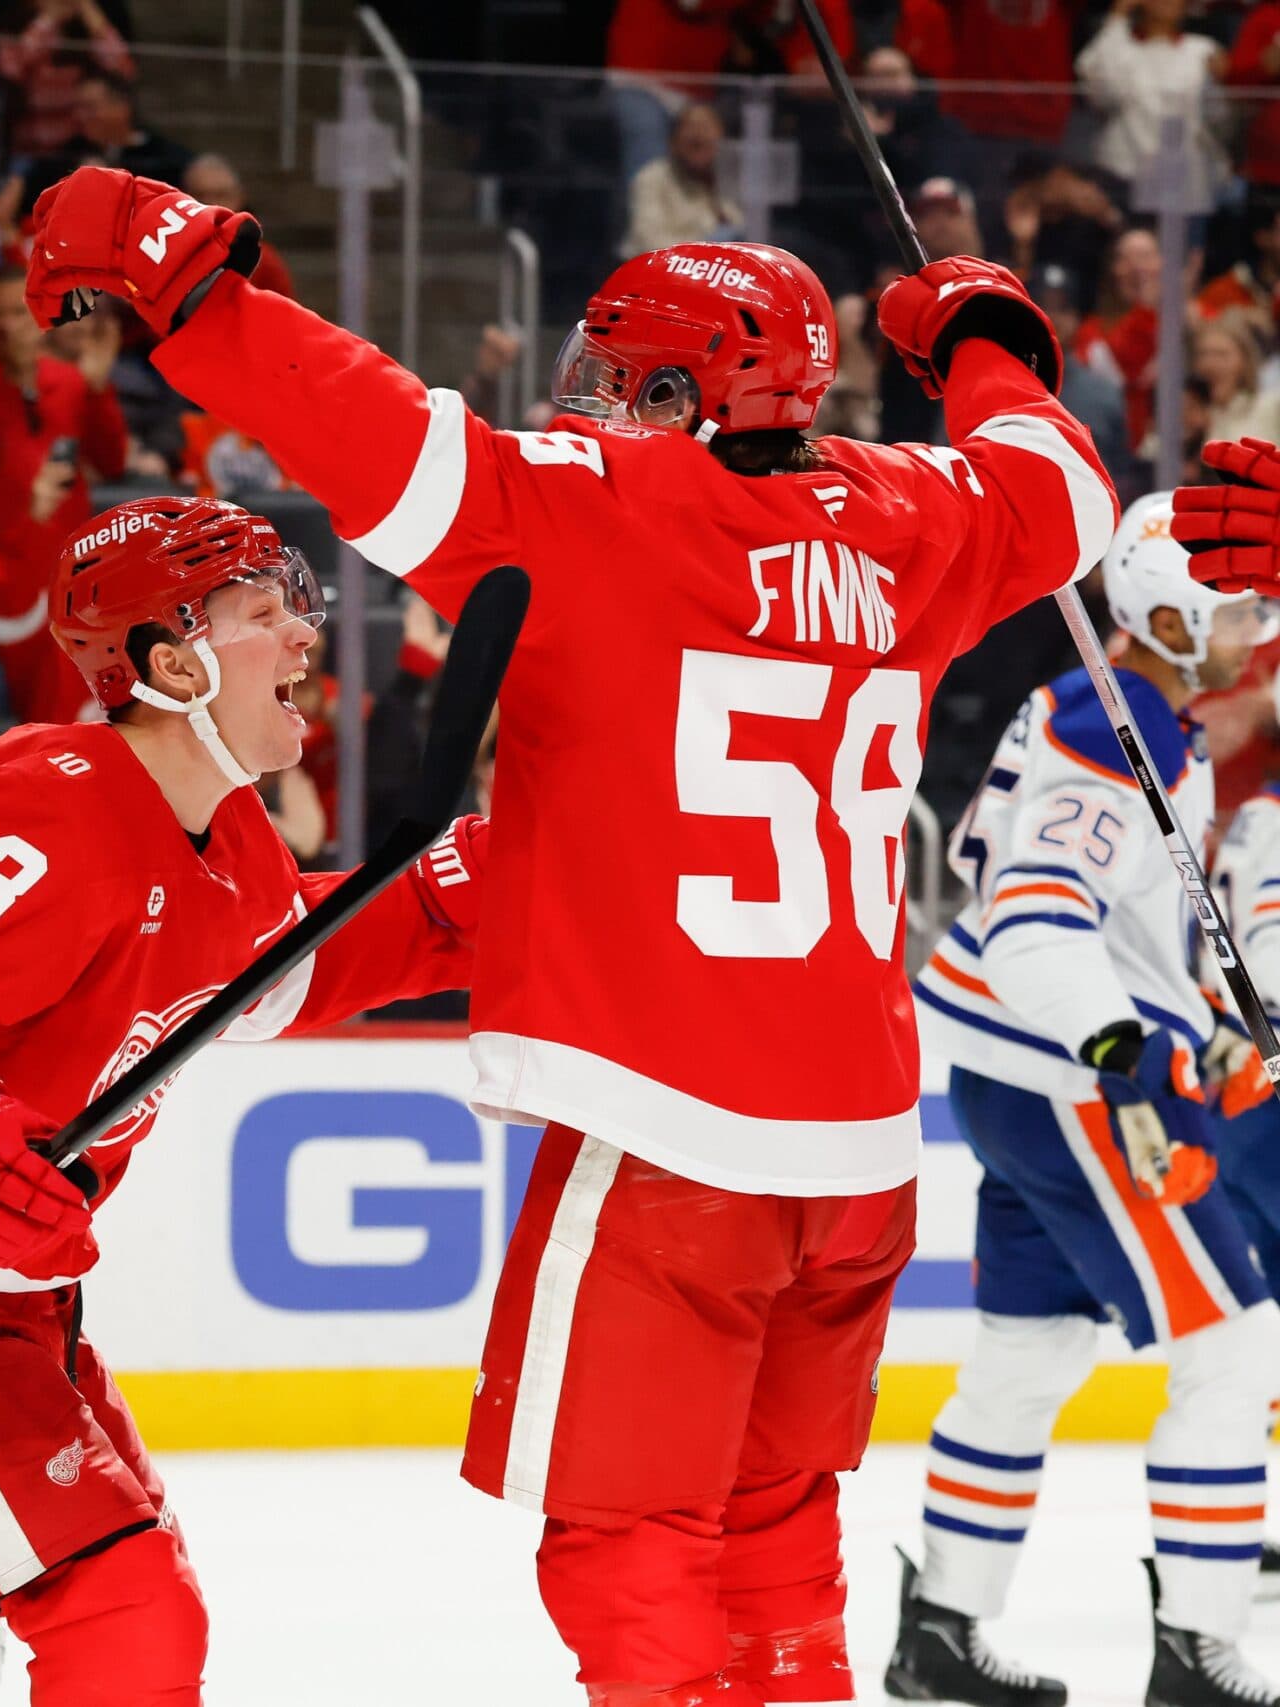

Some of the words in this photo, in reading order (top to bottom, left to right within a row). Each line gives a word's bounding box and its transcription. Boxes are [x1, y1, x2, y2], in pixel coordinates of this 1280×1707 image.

[667, 254, 757, 290] meijer
[805, 324, 828, 360] 58
[73, 513, 156, 560] meijer
[746, 540, 897, 655] FINNIE
[47, 752, 92, 776] 10
[675, 648, 922, 962] 58
[1035, 793, 1126, 870] 25
[1169, 849, 1238, 969] CCM
[229, 1090, 546, 1314] G
